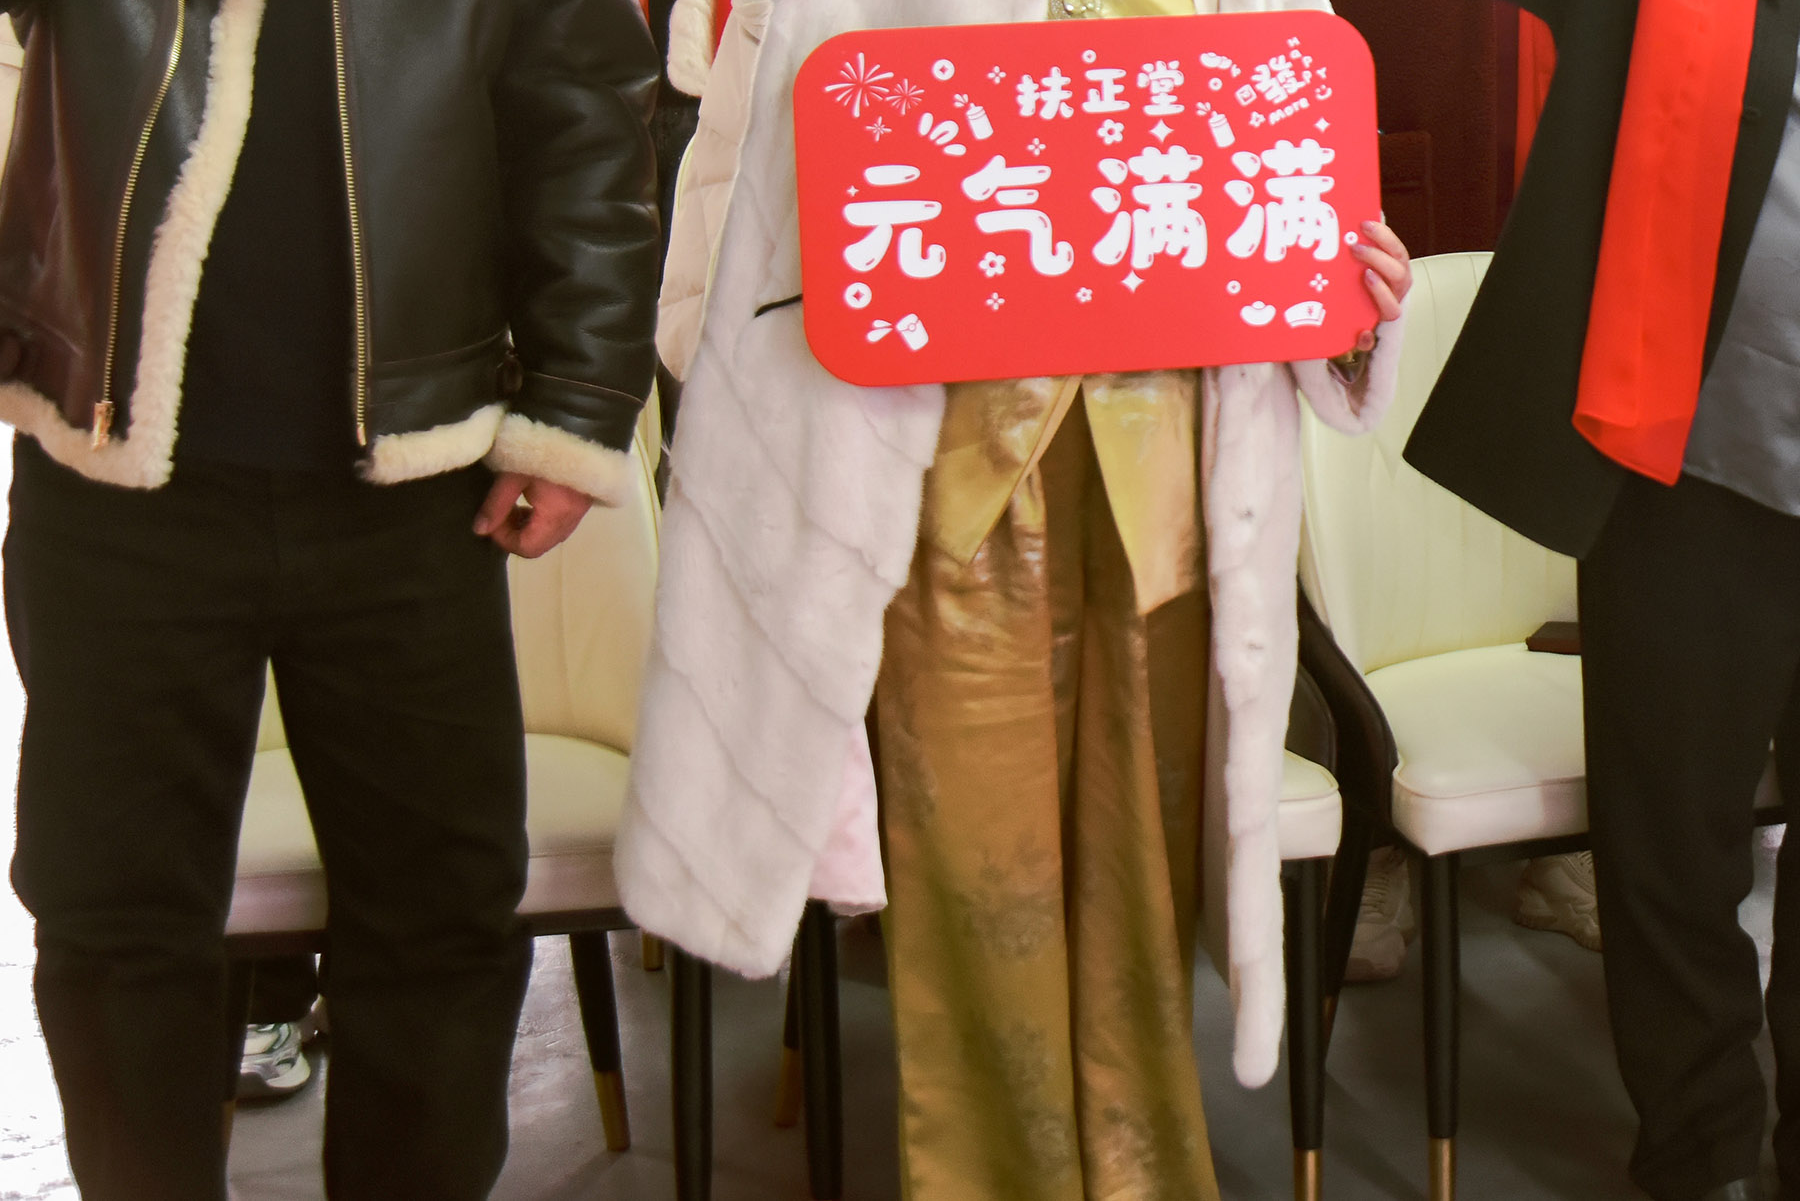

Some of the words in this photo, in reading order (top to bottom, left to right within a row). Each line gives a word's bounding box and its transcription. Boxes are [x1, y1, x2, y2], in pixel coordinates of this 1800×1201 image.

[1016, 60, 1186, 120] 扶正堂
[842, 139, 1341, 279] 元气满满
